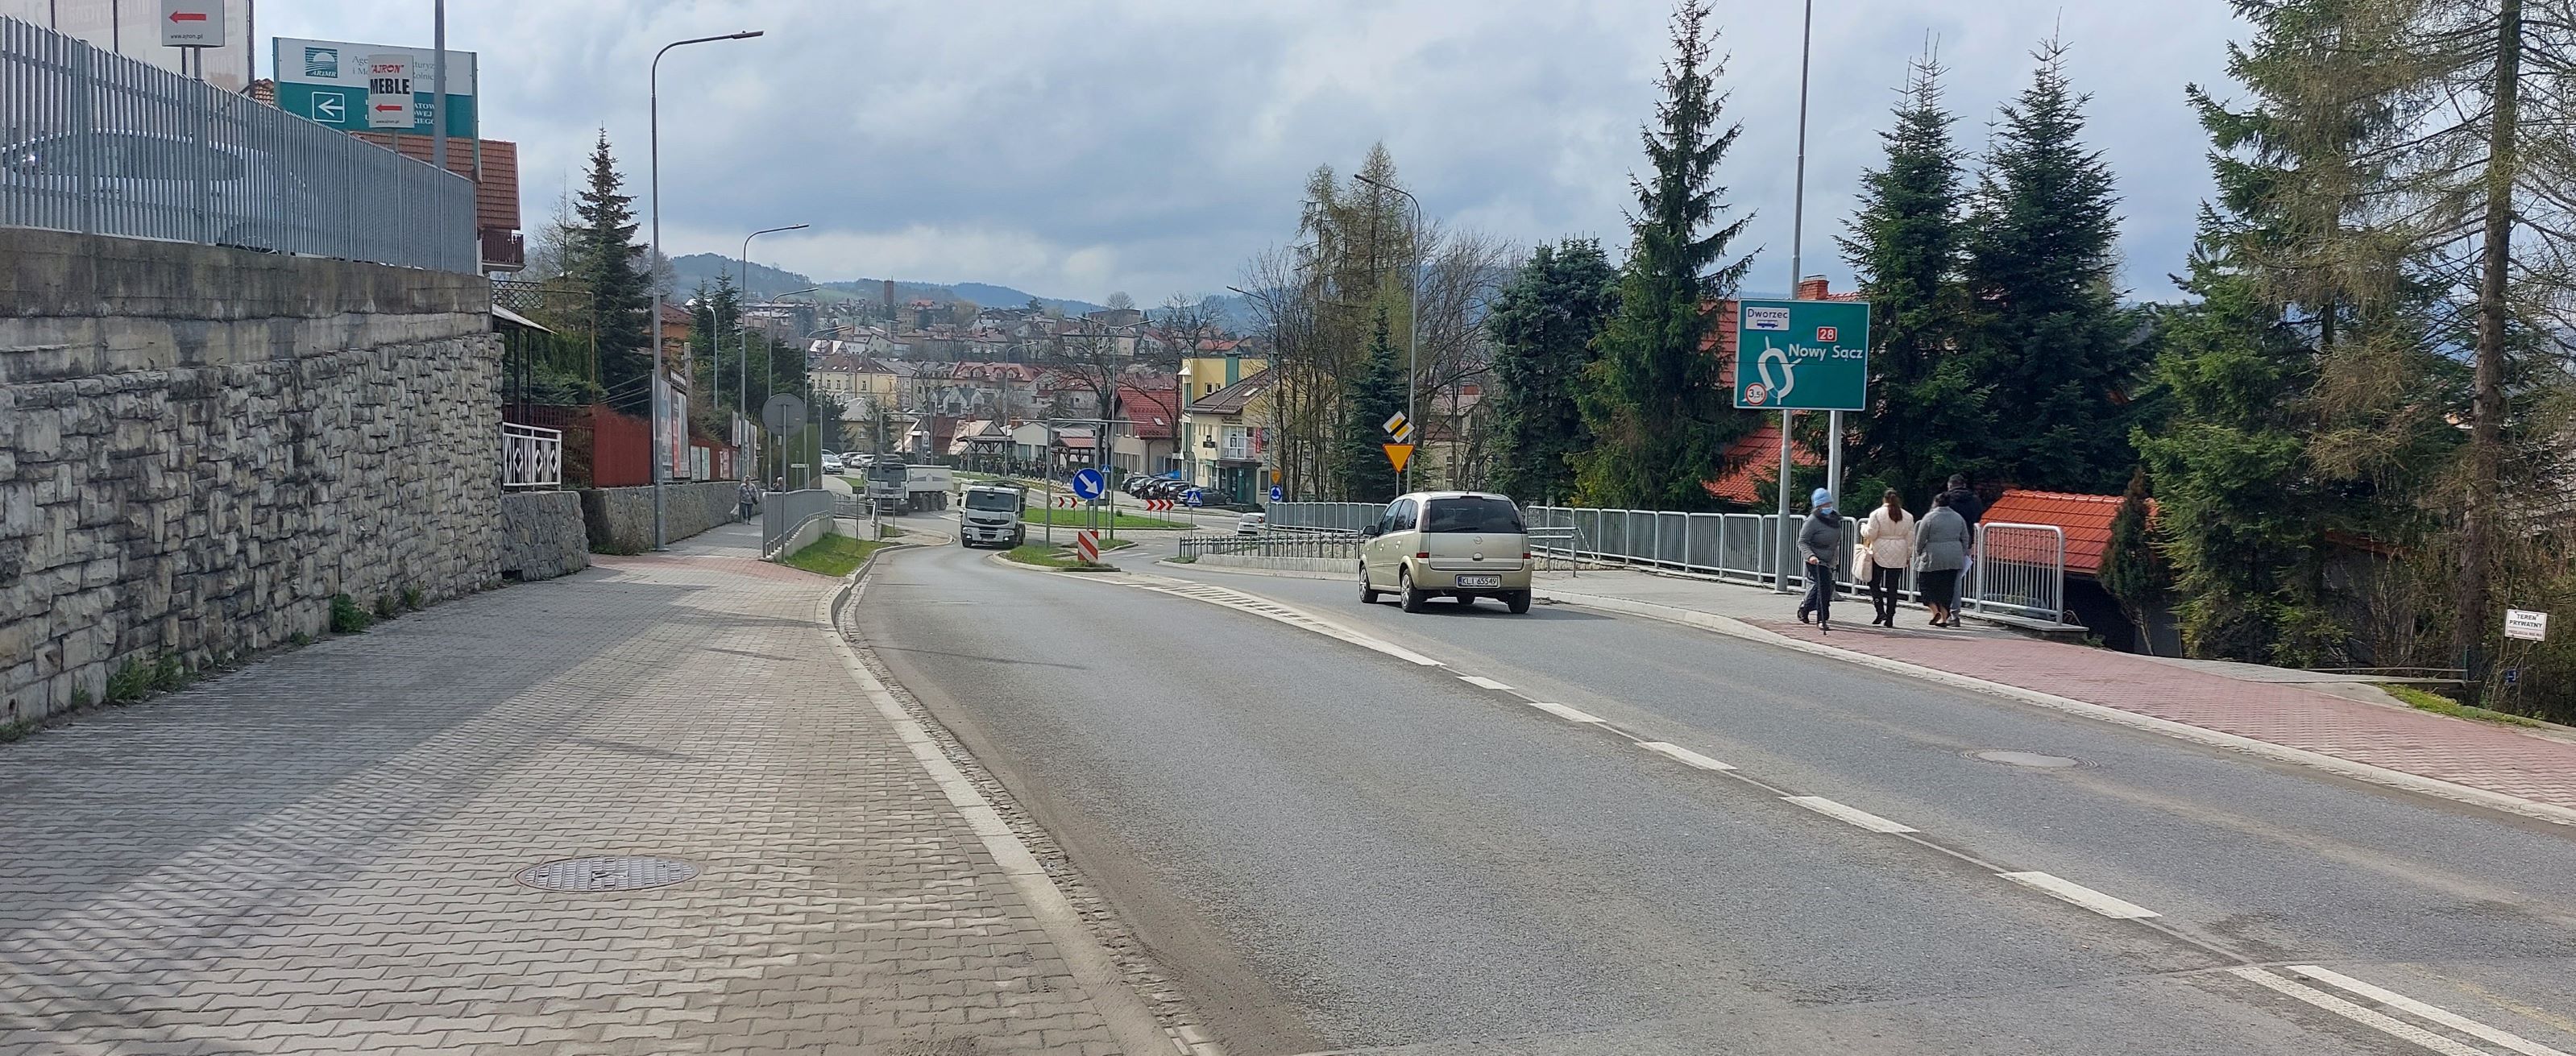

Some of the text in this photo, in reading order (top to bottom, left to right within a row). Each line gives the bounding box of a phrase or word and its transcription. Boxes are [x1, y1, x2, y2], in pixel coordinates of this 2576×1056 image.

[370, 78, 410, 95] MEBLE
[1747, 309, 1788, 319] Dworzec
[1819, 329, 1834, 340] 28
[1788, 343, 1863, 361] Nowy Sącz
[1748, 388, 1763, 398] 3,5t
